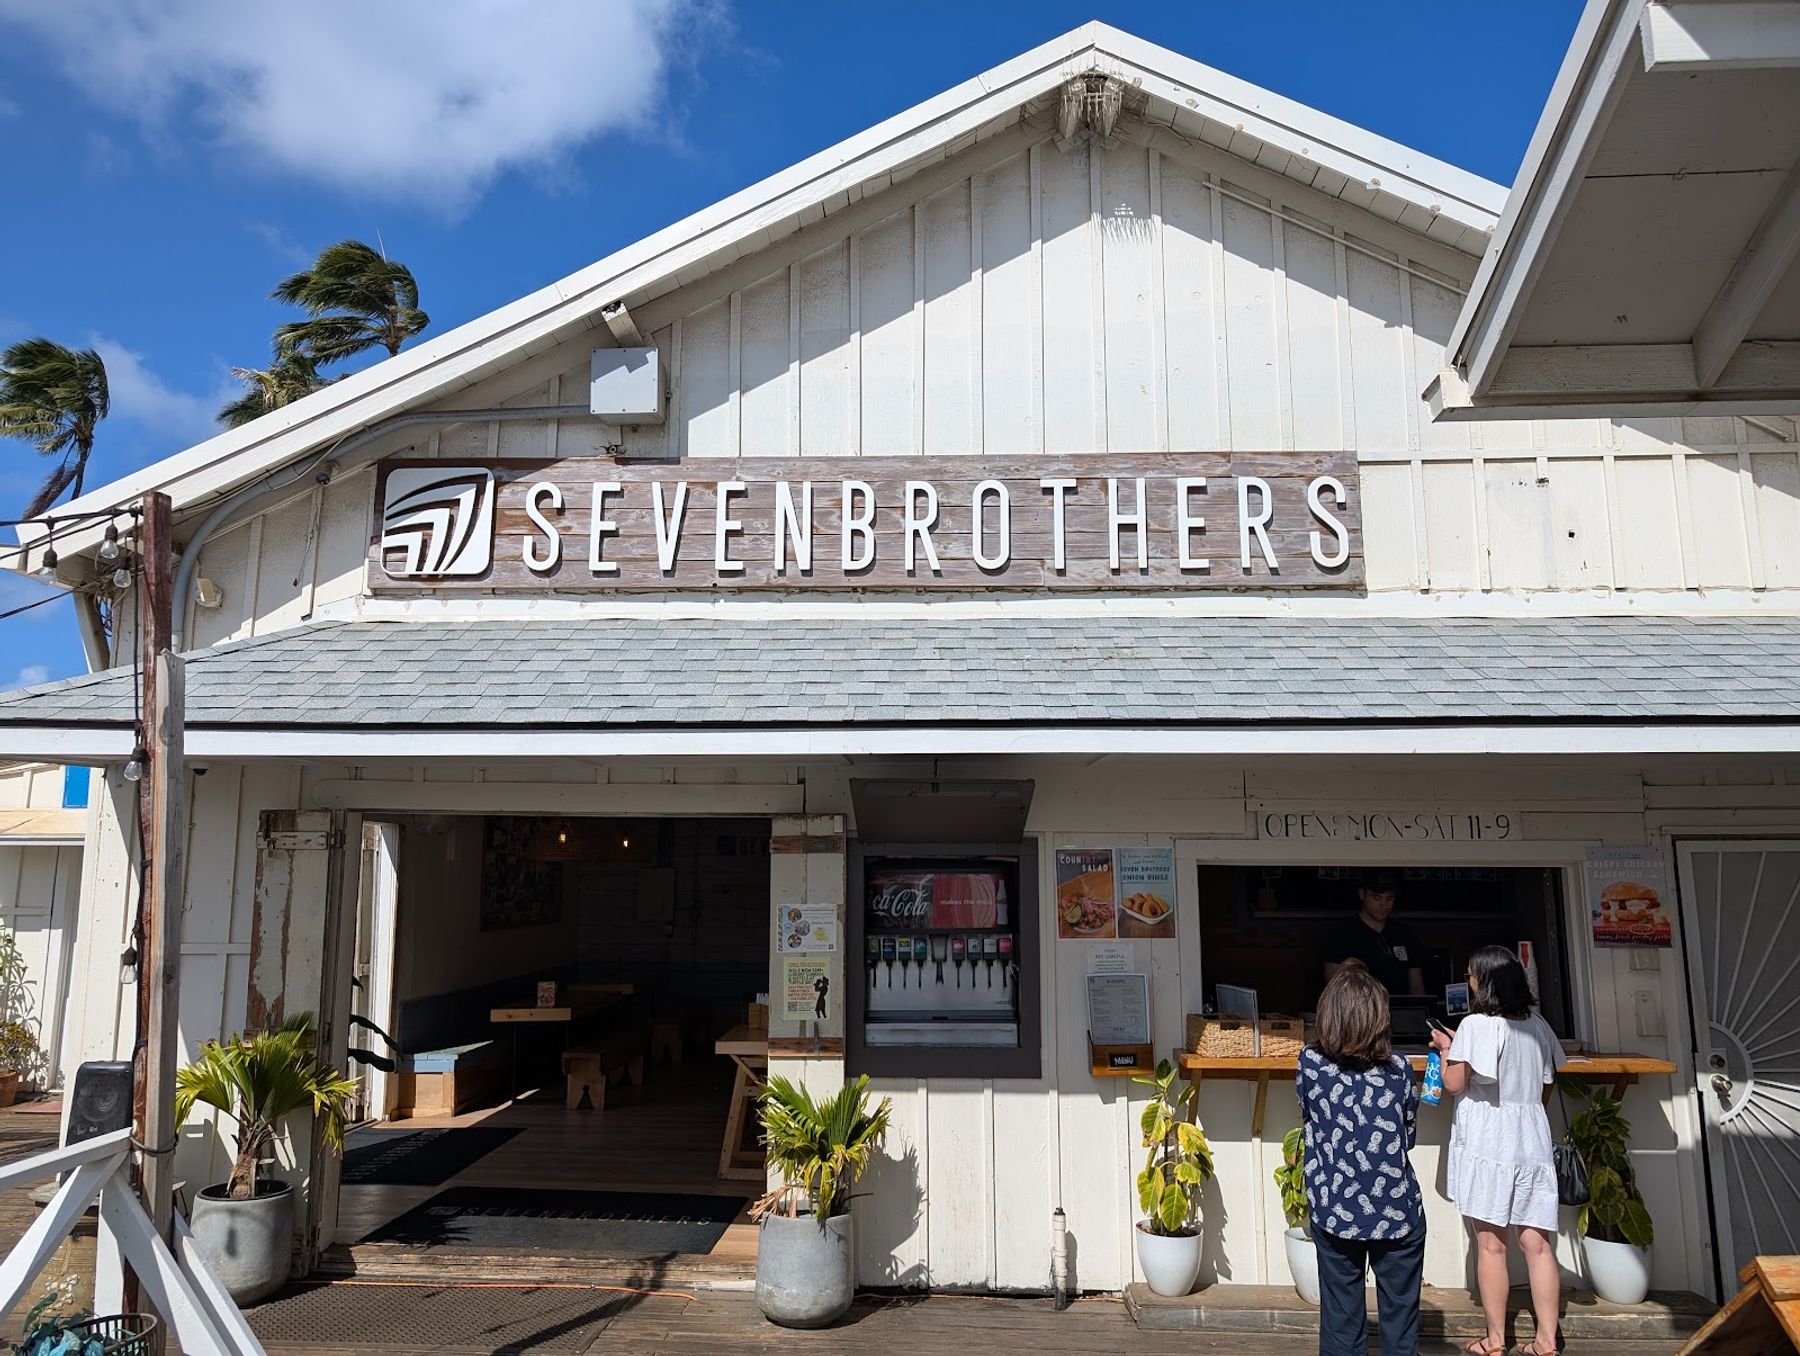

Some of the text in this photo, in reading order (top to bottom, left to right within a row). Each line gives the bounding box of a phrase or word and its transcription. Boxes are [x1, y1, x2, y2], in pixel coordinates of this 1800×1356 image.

[1348, 813, 1456, 839] MON-SAT
[1467, 814, 1510, 839] 11-9
[1081, 864, 1109, 872] SALAD
